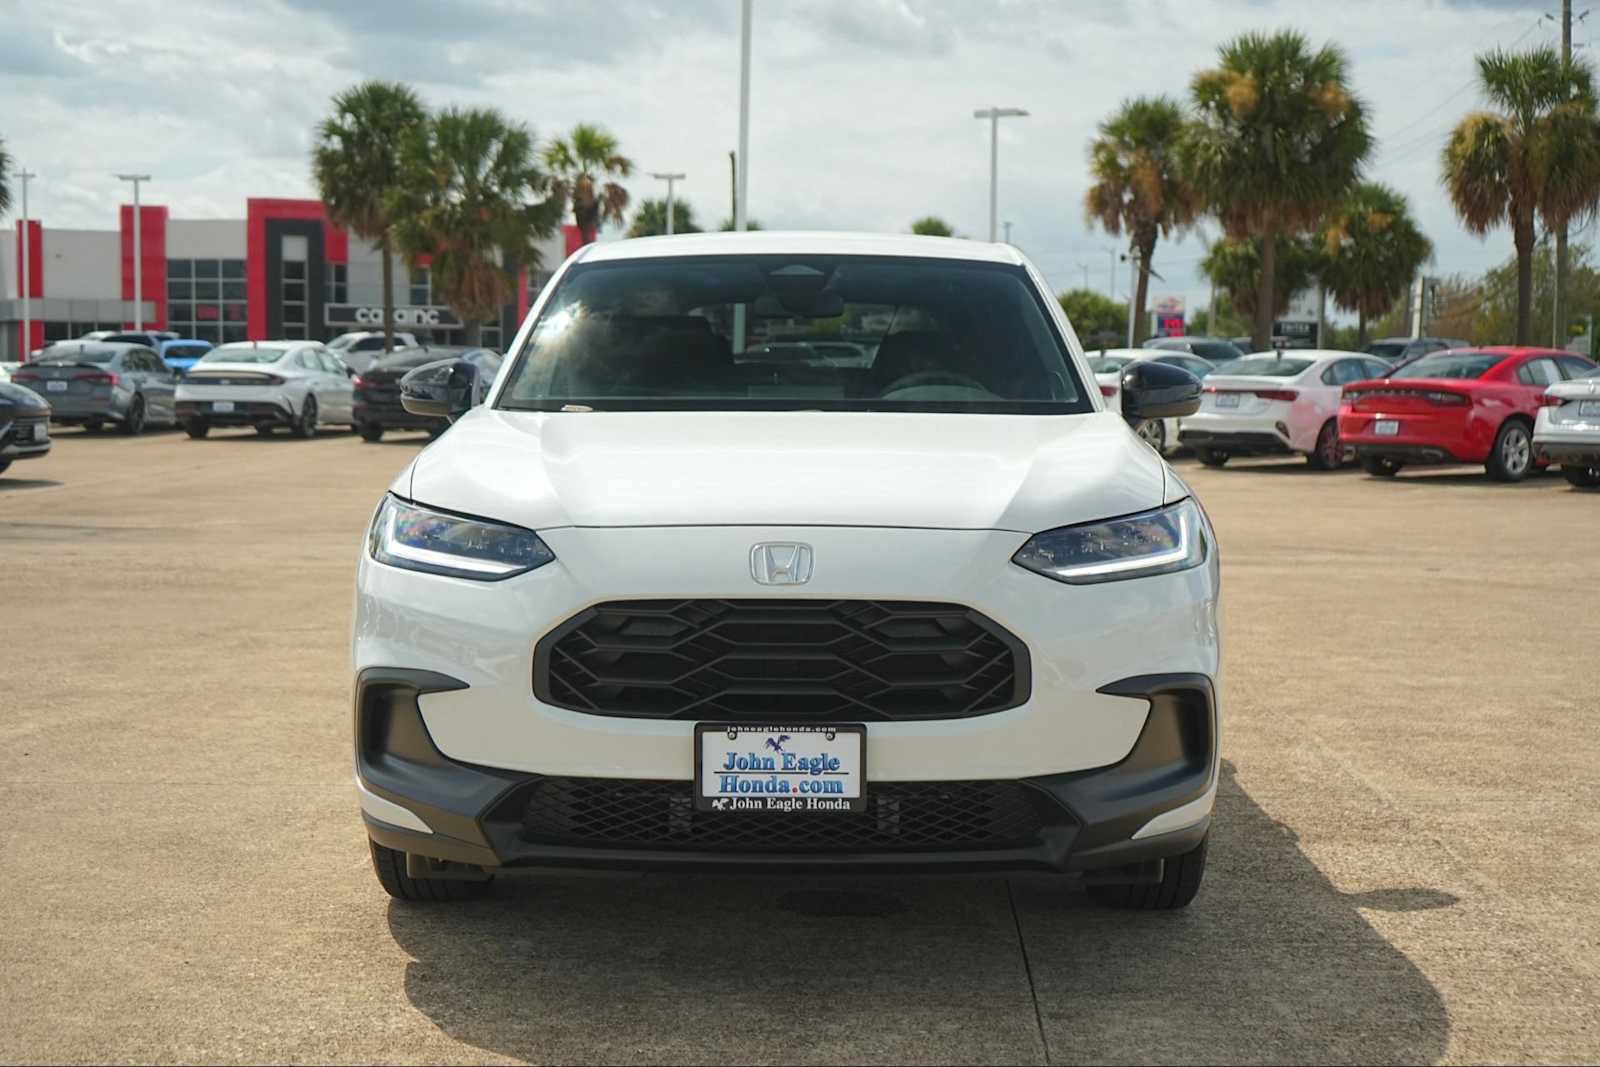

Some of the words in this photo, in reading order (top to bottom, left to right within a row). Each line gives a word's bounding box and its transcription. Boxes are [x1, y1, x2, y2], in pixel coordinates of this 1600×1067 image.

[723, 752, 775, 771] John
[781, 752, 841, 775] Eagle
[719, 775, 844, 794] Honda.com
[729, 798, 762, 810] John
[766, 798, 803, 812] Eagle
[806, 798, 851, 810] Honda
